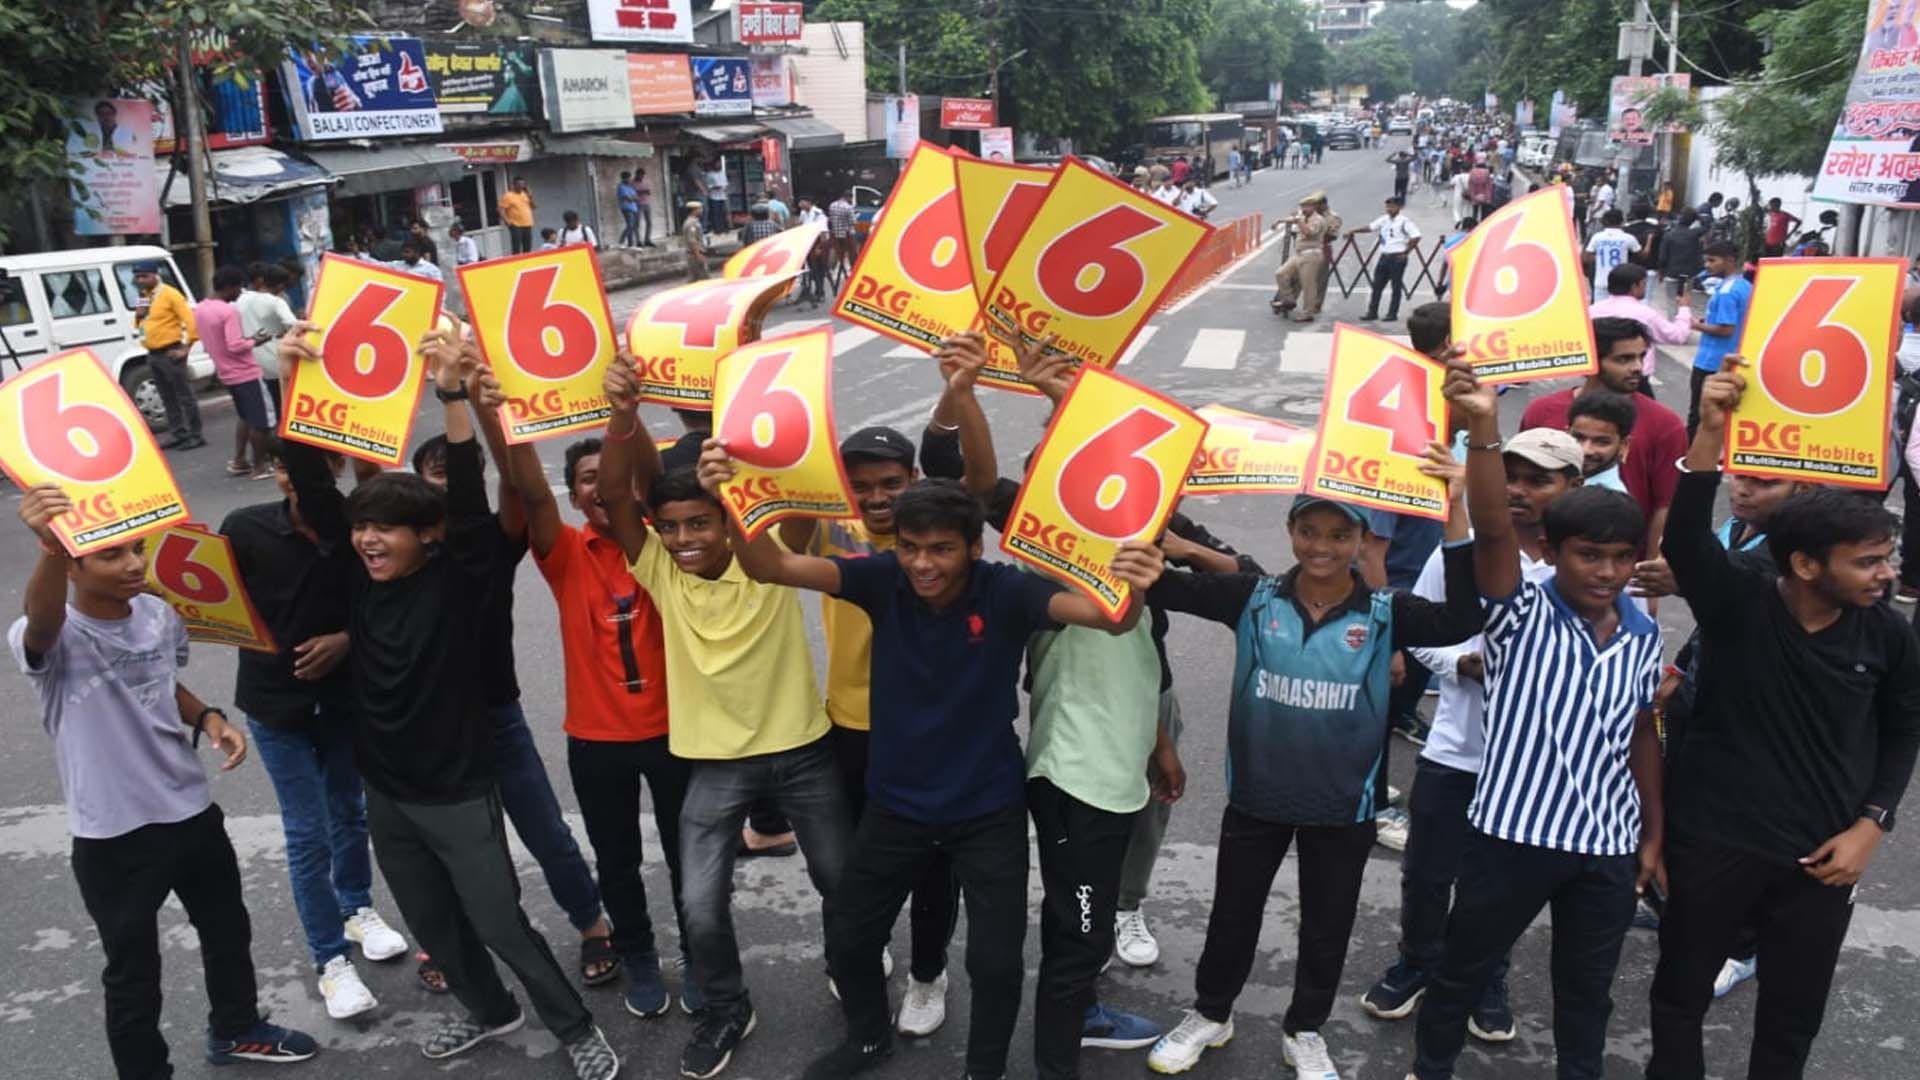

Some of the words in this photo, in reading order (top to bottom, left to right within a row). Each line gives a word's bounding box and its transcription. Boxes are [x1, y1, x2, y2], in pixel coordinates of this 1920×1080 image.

[313, 116, 351, 133] BALAJI
[355, 113, 436, 131] CONFECTIONERY
[1826, 145, 1876, 177] रमेश
[1035, 202, 1168, 319] 6
[1462, 208, 1561, 321] 6
[1600, 248, 1621, 267] 18
[651, 281, 735, 350] 4
[853, 276, 912, 317] DKG
[996, 287, 1052, 335] DKG
[321, 280, 410, 401] 6
[505, 263, 600, 382] 6
[854, 303, 898, 329] Multibrand
[900, 322, 928, 340] Mobile
[1515, 360, 1552, 371] Mobile
[1553, 356, 1587, 366] Outlet
[1517, 341, 1583, 358] Mobiles
[1758, 275, 1872, 418] 6
[507, 390, 564, 418] DKG
[569, 394, 609, 411] Mobil
[680, 389, 706, 398] Mobile
[719, 347, 813, 471] 6
[1345, 352, 1438, 459] 4
[19, 369, 136, 485] 6
[295, 393, 348, 428] DKG
[350, 420, 399, 445] Mobiles
[522, 416, 569, 433] Multibrand
[570, 412, 599, 423] Mobile
[299, 424, 344, 442] Multibrand
[346, 435, 371, 450] Mobile
[372, 442, 397, 457] Outlet
[1737, 420, 1801, 450] DKG
[1807, 444, 1875, 463] Mobiles
[1056, 405, 1180, 541] 6
[1188, 476, 1195, 484] A
[1197, 476, 1237, 484] Multibrand
[1239, 475, 1267, 483] Mobile
[1269, 475, 1297, 484] Outlet
[1242, 460, 1299, 473] Mobiles
[1324, 450, 1381, 482] DKG
[1384, 477, 1441, 499] Mobiles
[1735, 455, 1743, 463] A
[1745, 455, 1801, 468] Multibrand
[1804, 460, 1840, 472] Mobile
[1842, 464, 1876, 476] Outlet
[122, 493, 174, 514] Mobiles
[1328, 481, 1378, 498] Multibrand
[1380, 490, 1409, 503] Mobile
[1412, 496, 1441, 509] Outlet
[83, 522, 128, 542] Multibrand
[127, 514, 157, 527] Mobile
[157, 504, 180, 518] Outlet
[1017, 512, 1077, 555] DKG
[152, 532, 230, 605] 6
[1012, 538, 1019, 546] A
[1020, 540, 1068, 569] Multibrand
[1070, 561, 1098, 586] Mobile
[1099, 583, 1118, 605] Outlet
[1256, 669, 1360, 711] SMAASHHIT
